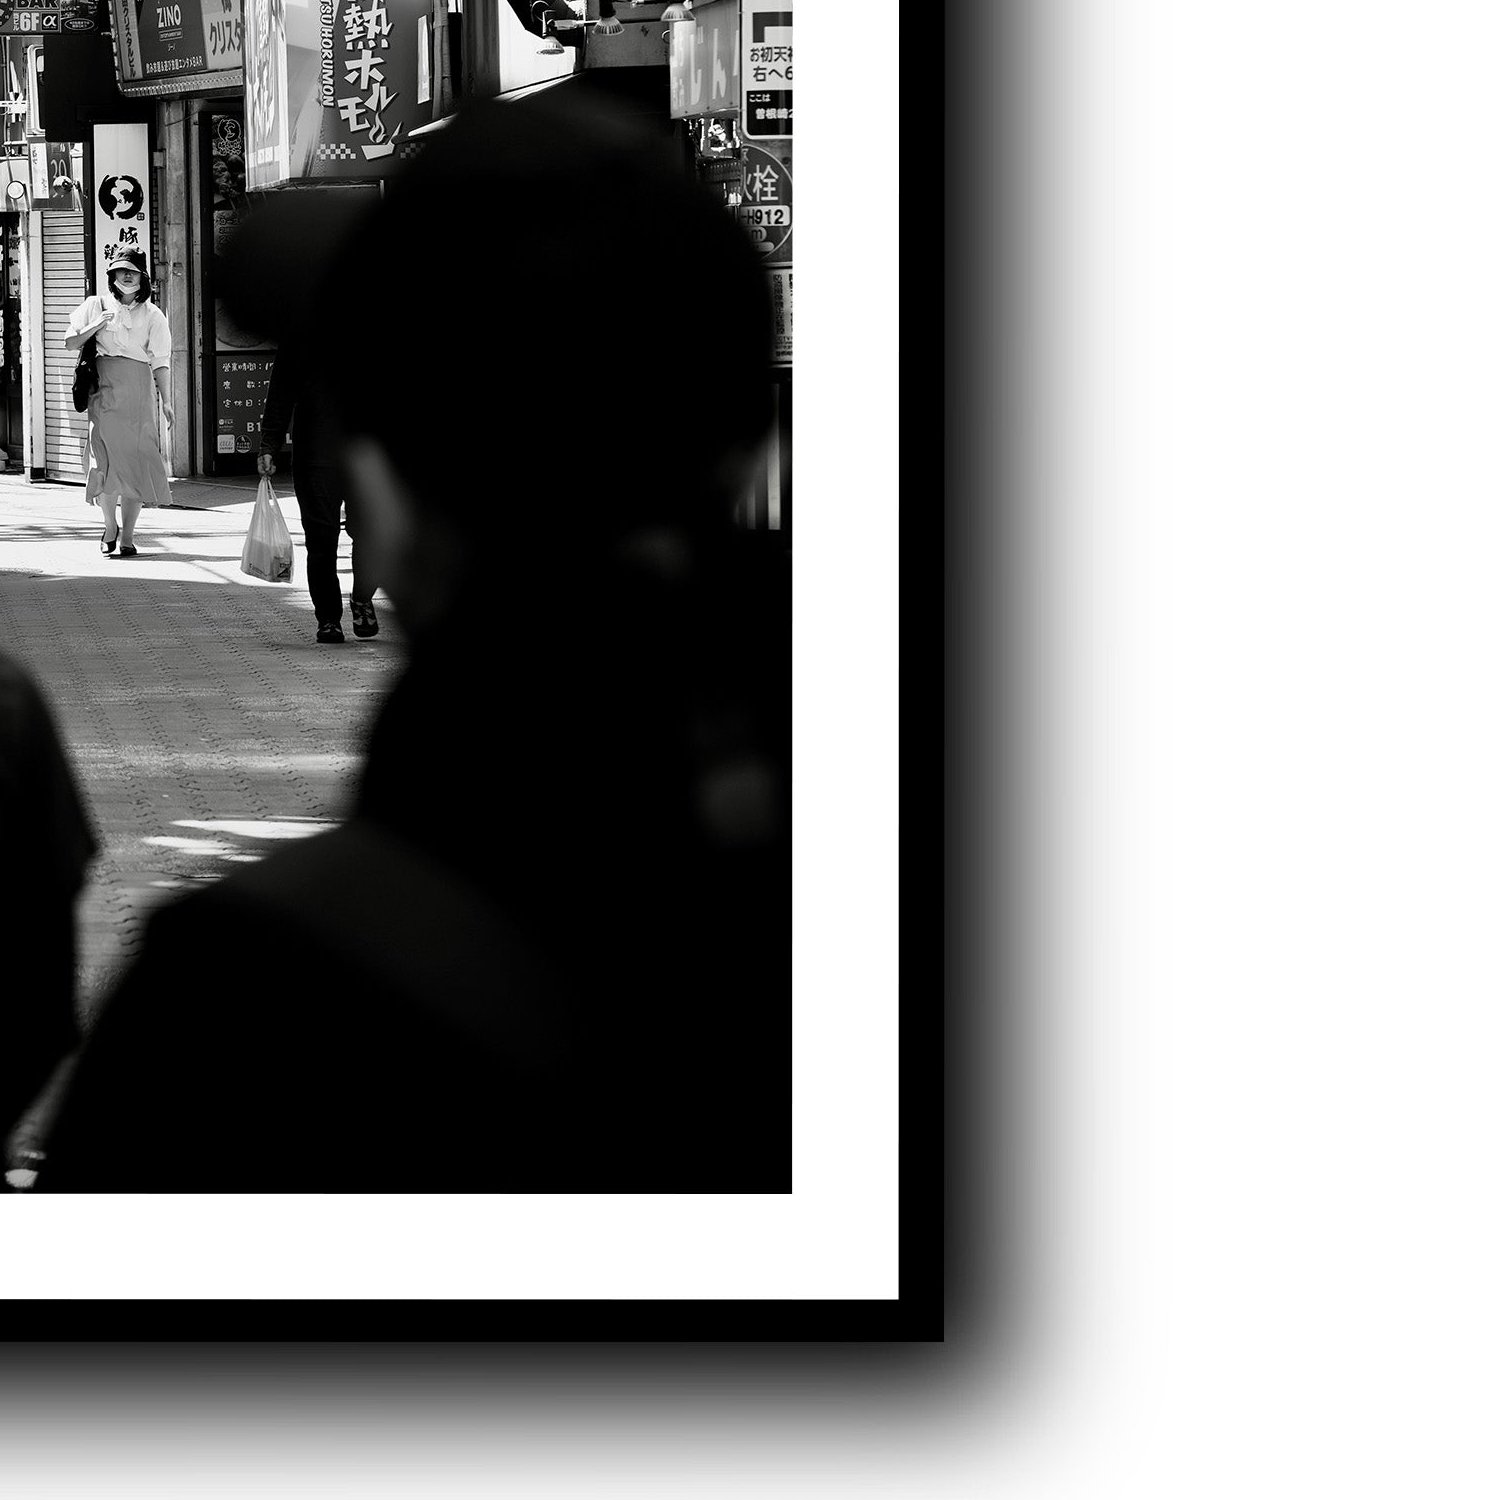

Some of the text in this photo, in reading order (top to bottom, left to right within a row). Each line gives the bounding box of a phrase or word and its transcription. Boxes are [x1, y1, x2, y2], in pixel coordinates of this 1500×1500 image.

[19, 11, 41, 32] 6F
[156, 4, 182, 29] ZINO
[320, 34, 336, 108] HORUMON
[748, 93, 771, 103] ここは
